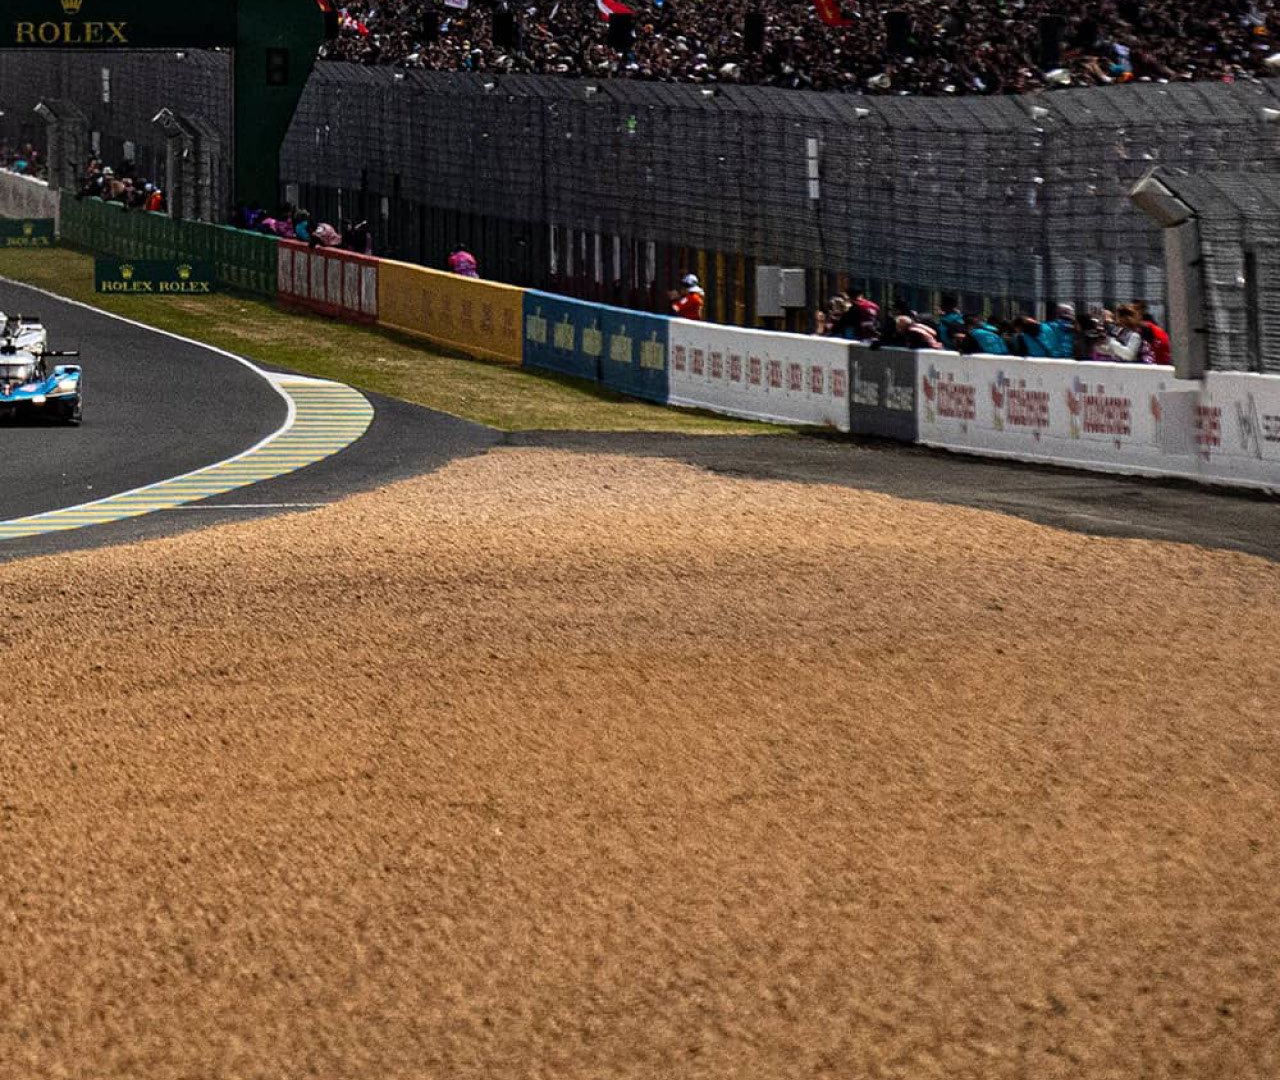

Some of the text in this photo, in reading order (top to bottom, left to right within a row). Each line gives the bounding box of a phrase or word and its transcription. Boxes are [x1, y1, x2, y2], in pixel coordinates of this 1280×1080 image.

[16, 22, 129, 44] ROLEX
[101, 280, 211, 293] ROLEX ROLEX
